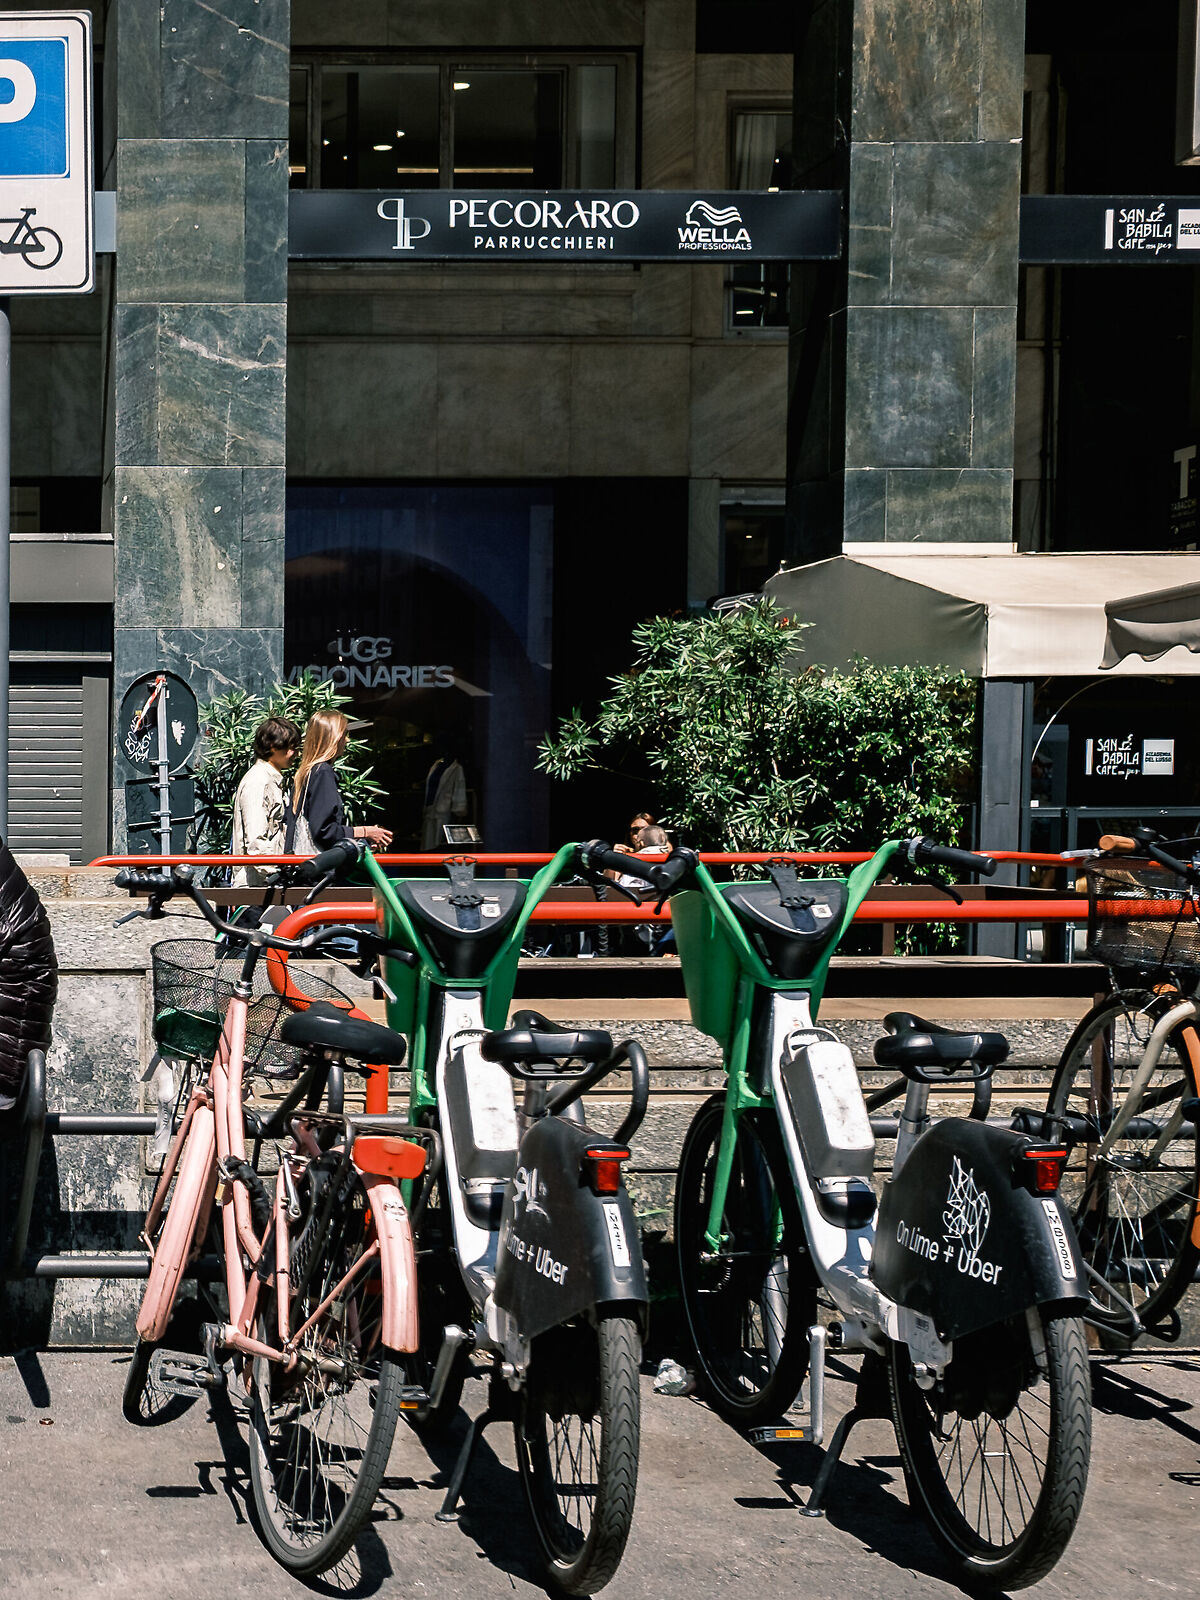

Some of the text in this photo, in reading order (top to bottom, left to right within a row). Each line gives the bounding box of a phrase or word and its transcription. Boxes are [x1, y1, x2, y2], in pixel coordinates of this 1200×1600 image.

[448, 199, 640, 229] PECORARO
[1118, 208, 1145, 223] SAN
[677, 226, 753, 243] WELLA
[1125, 223, 1173, 238] BABILA
[473, 235, 615, 250] PARRUCCHIERI
[678, 242, 753, 251] PROFESSIONALS
[1173, 445, 1197, 499] T
[337, 636, 392, 663] UGG
[1096, 738, 1118, 752] SAN
[1102, 751, 1140, 765] BABILA
[896, 1220, 909, 1247] On
[909, 1226, 939, 1261] Lime
[958, 1248, 1003, 1285] Uber
[535, 1246, 569, 1286] Uber
